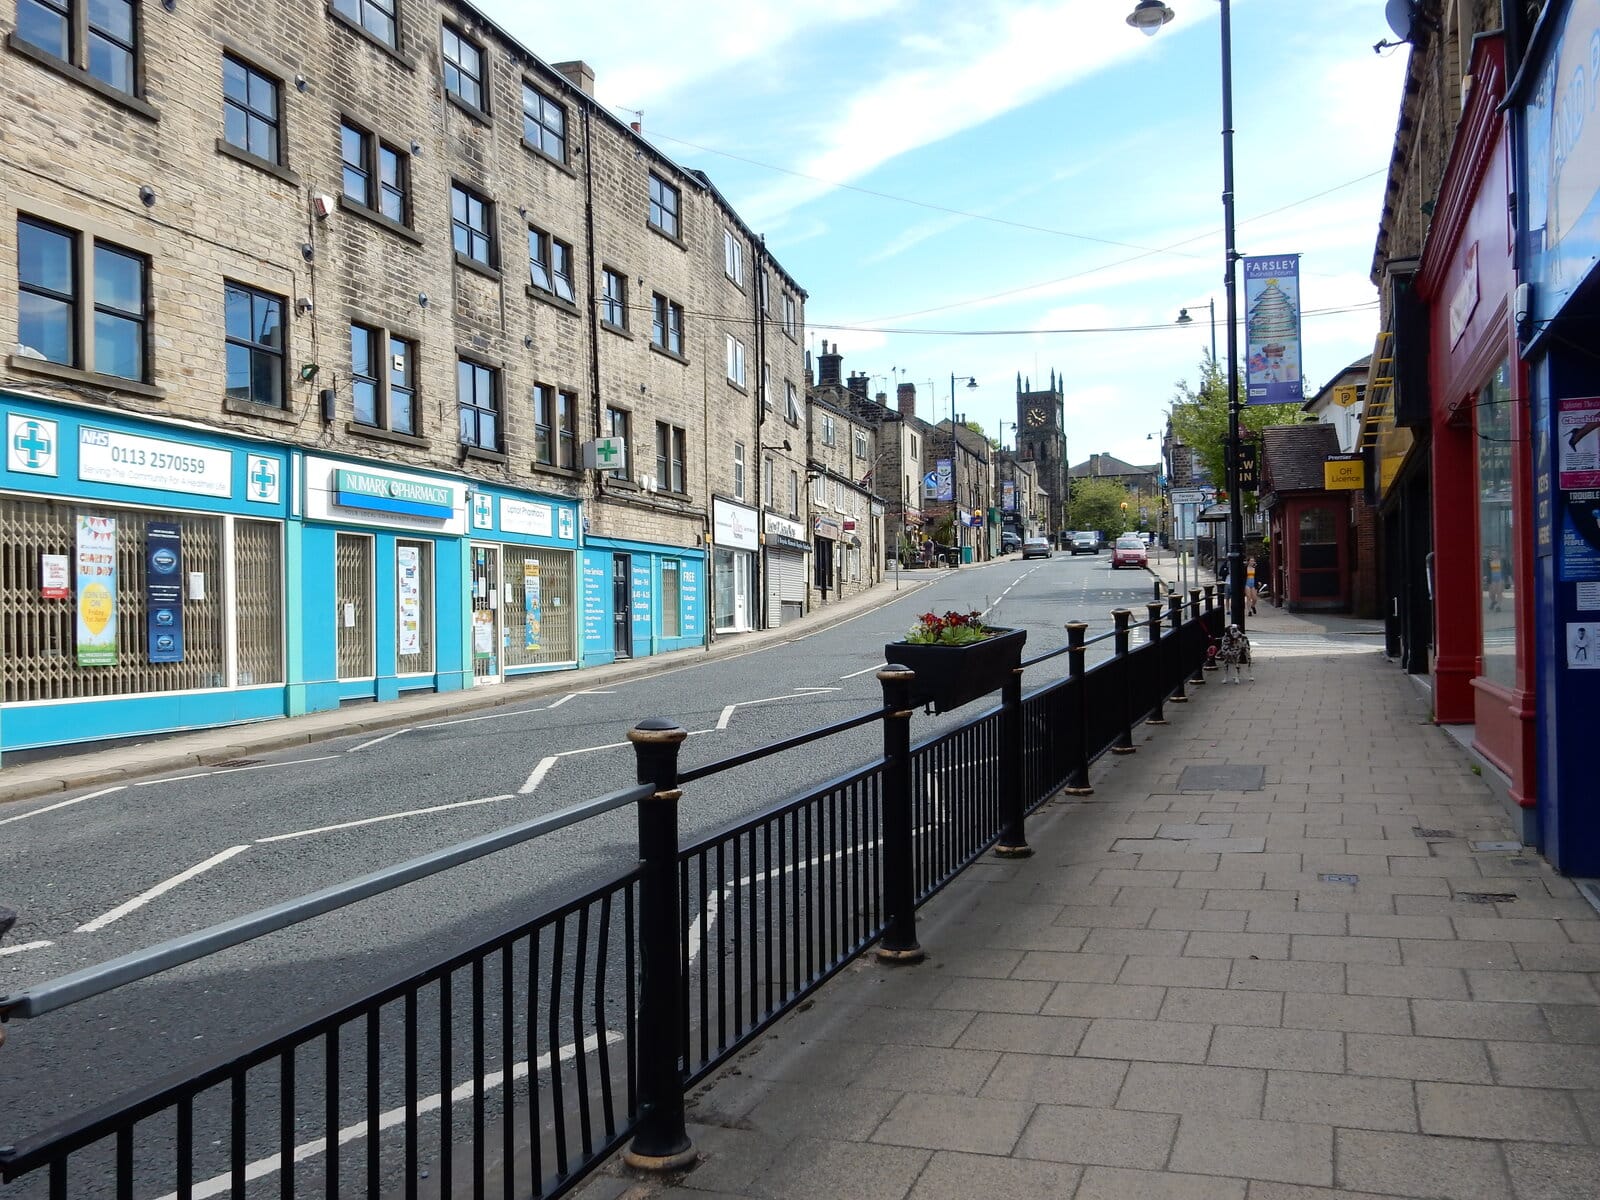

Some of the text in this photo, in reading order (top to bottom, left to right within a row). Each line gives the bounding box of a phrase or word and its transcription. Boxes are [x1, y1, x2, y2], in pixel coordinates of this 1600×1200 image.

[1552, 64, 1585, 183] AND
[1246, 260, 1295, 271] FARSLEY
[82, 430, 109, 446] NHS
[111, 446, 205, 475] 0113 2570559
[83, 464, 111, 478] Serving
[128, 470, 167, 485] Community
[1332, 474, 1360, 482] Licence
[346, 473, 449, 504] NUMARK PHARMACIST
[79, 552, 113, 564] CHARITY
[80, 565, 113, 576] FUN DAY
[683, 572, 695, 583] FREE
